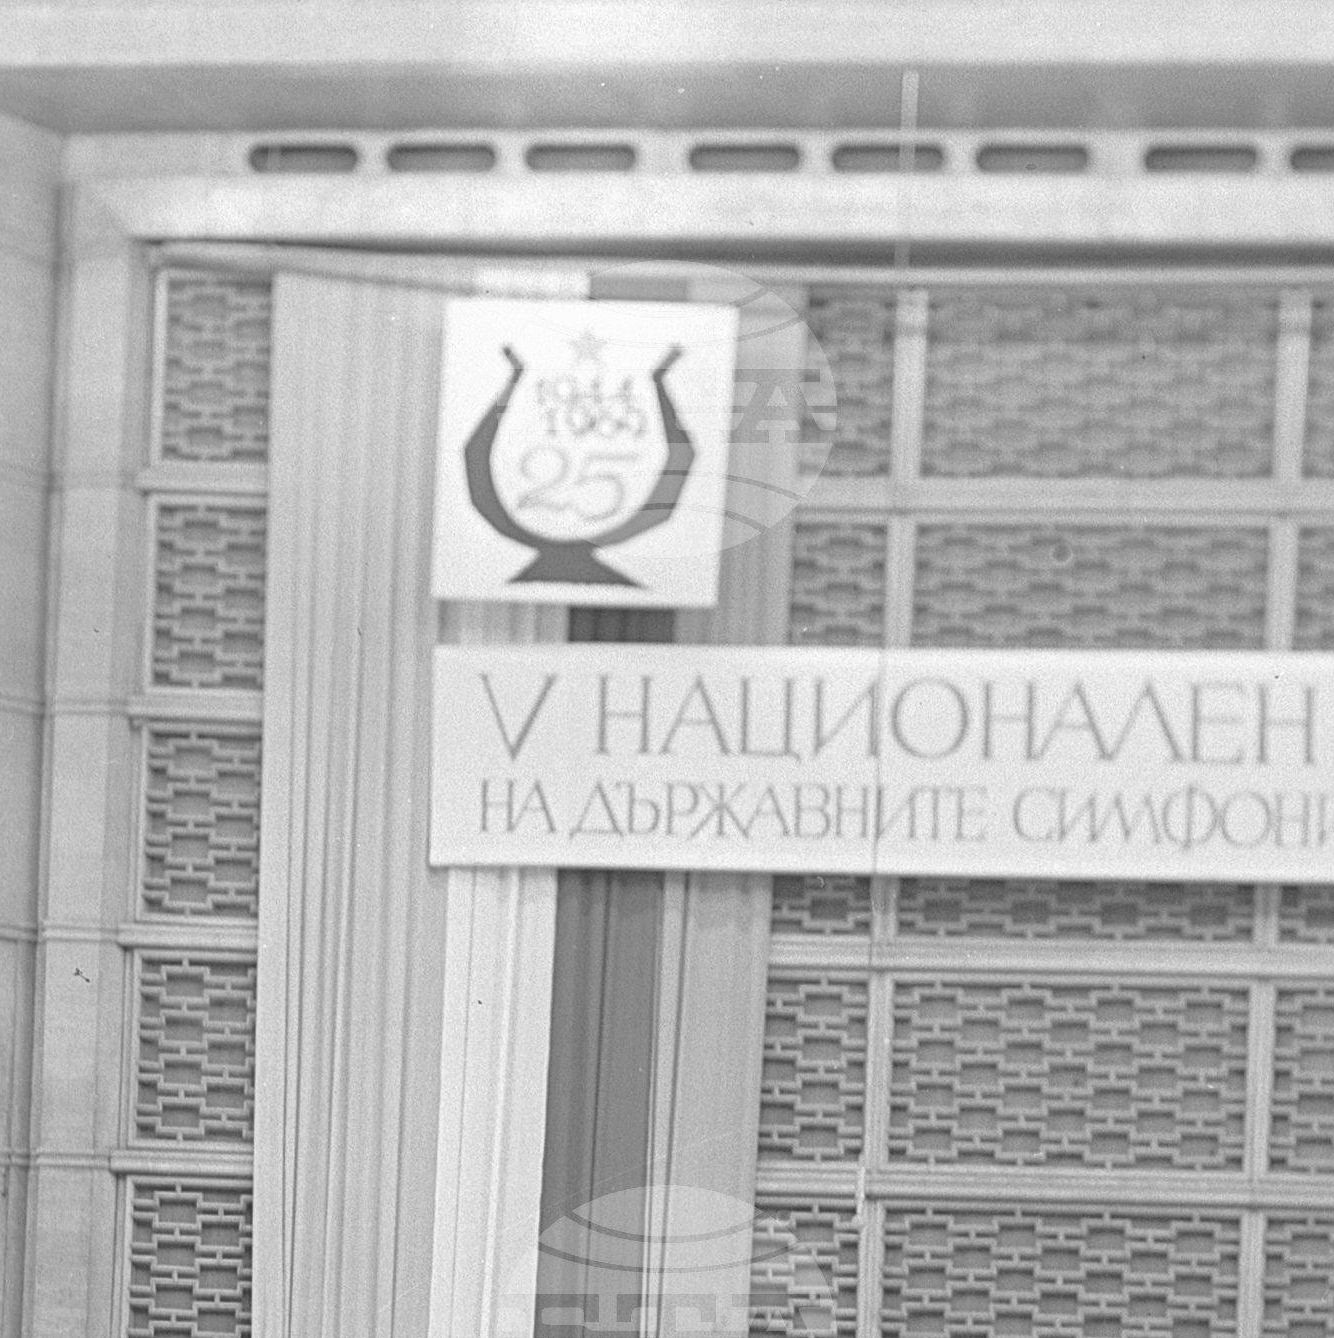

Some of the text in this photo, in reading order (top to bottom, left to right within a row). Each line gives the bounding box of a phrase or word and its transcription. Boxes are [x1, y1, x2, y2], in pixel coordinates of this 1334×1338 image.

[515, 444, 641, 523] 25
[479, 672, 559, 762] V
[594, 673, 1316, 767] НАЦИОНАЛЕН
[478, 777, 558, 836] НА
[569, 780, 988, 843] ДЪРЖАВНИТЕ
